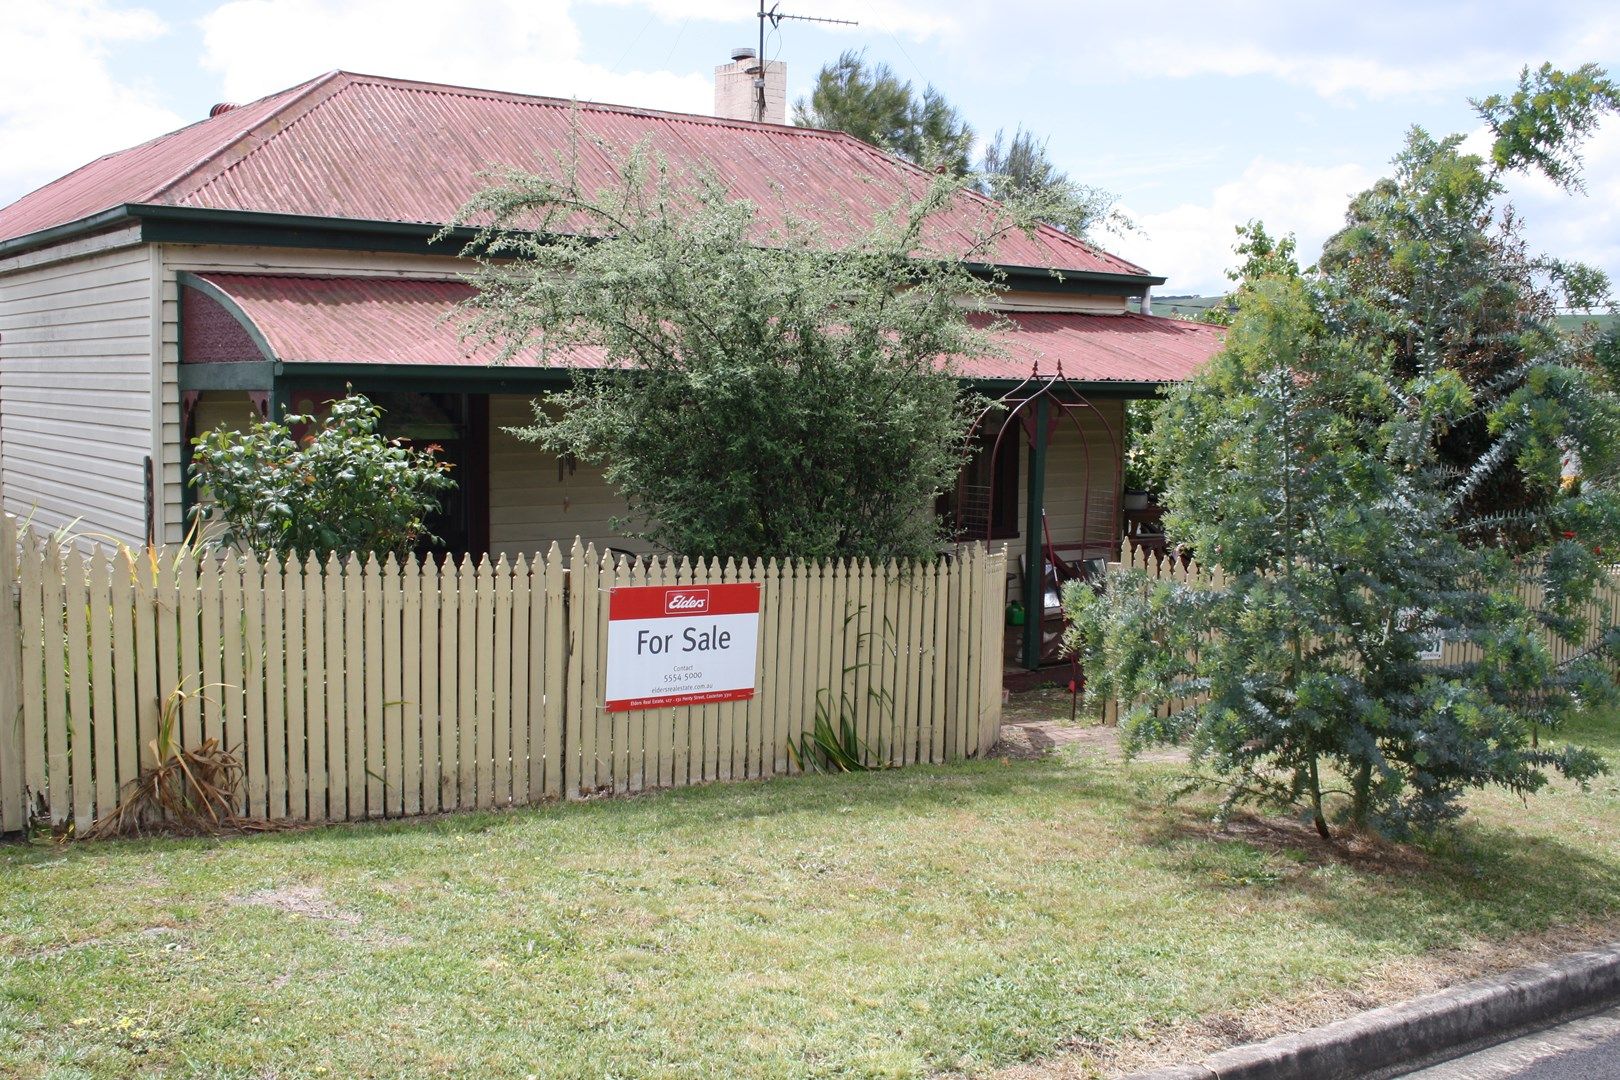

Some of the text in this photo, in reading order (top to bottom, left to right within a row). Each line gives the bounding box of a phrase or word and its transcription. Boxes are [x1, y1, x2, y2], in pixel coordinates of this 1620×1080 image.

[668, 595, 706, 609] Elders
[637, 624, 731, 655] For Sale
[664, 672, 703, 683] 5554 5000
[652, 683, 713, 694] eldersrealestate.com.au
